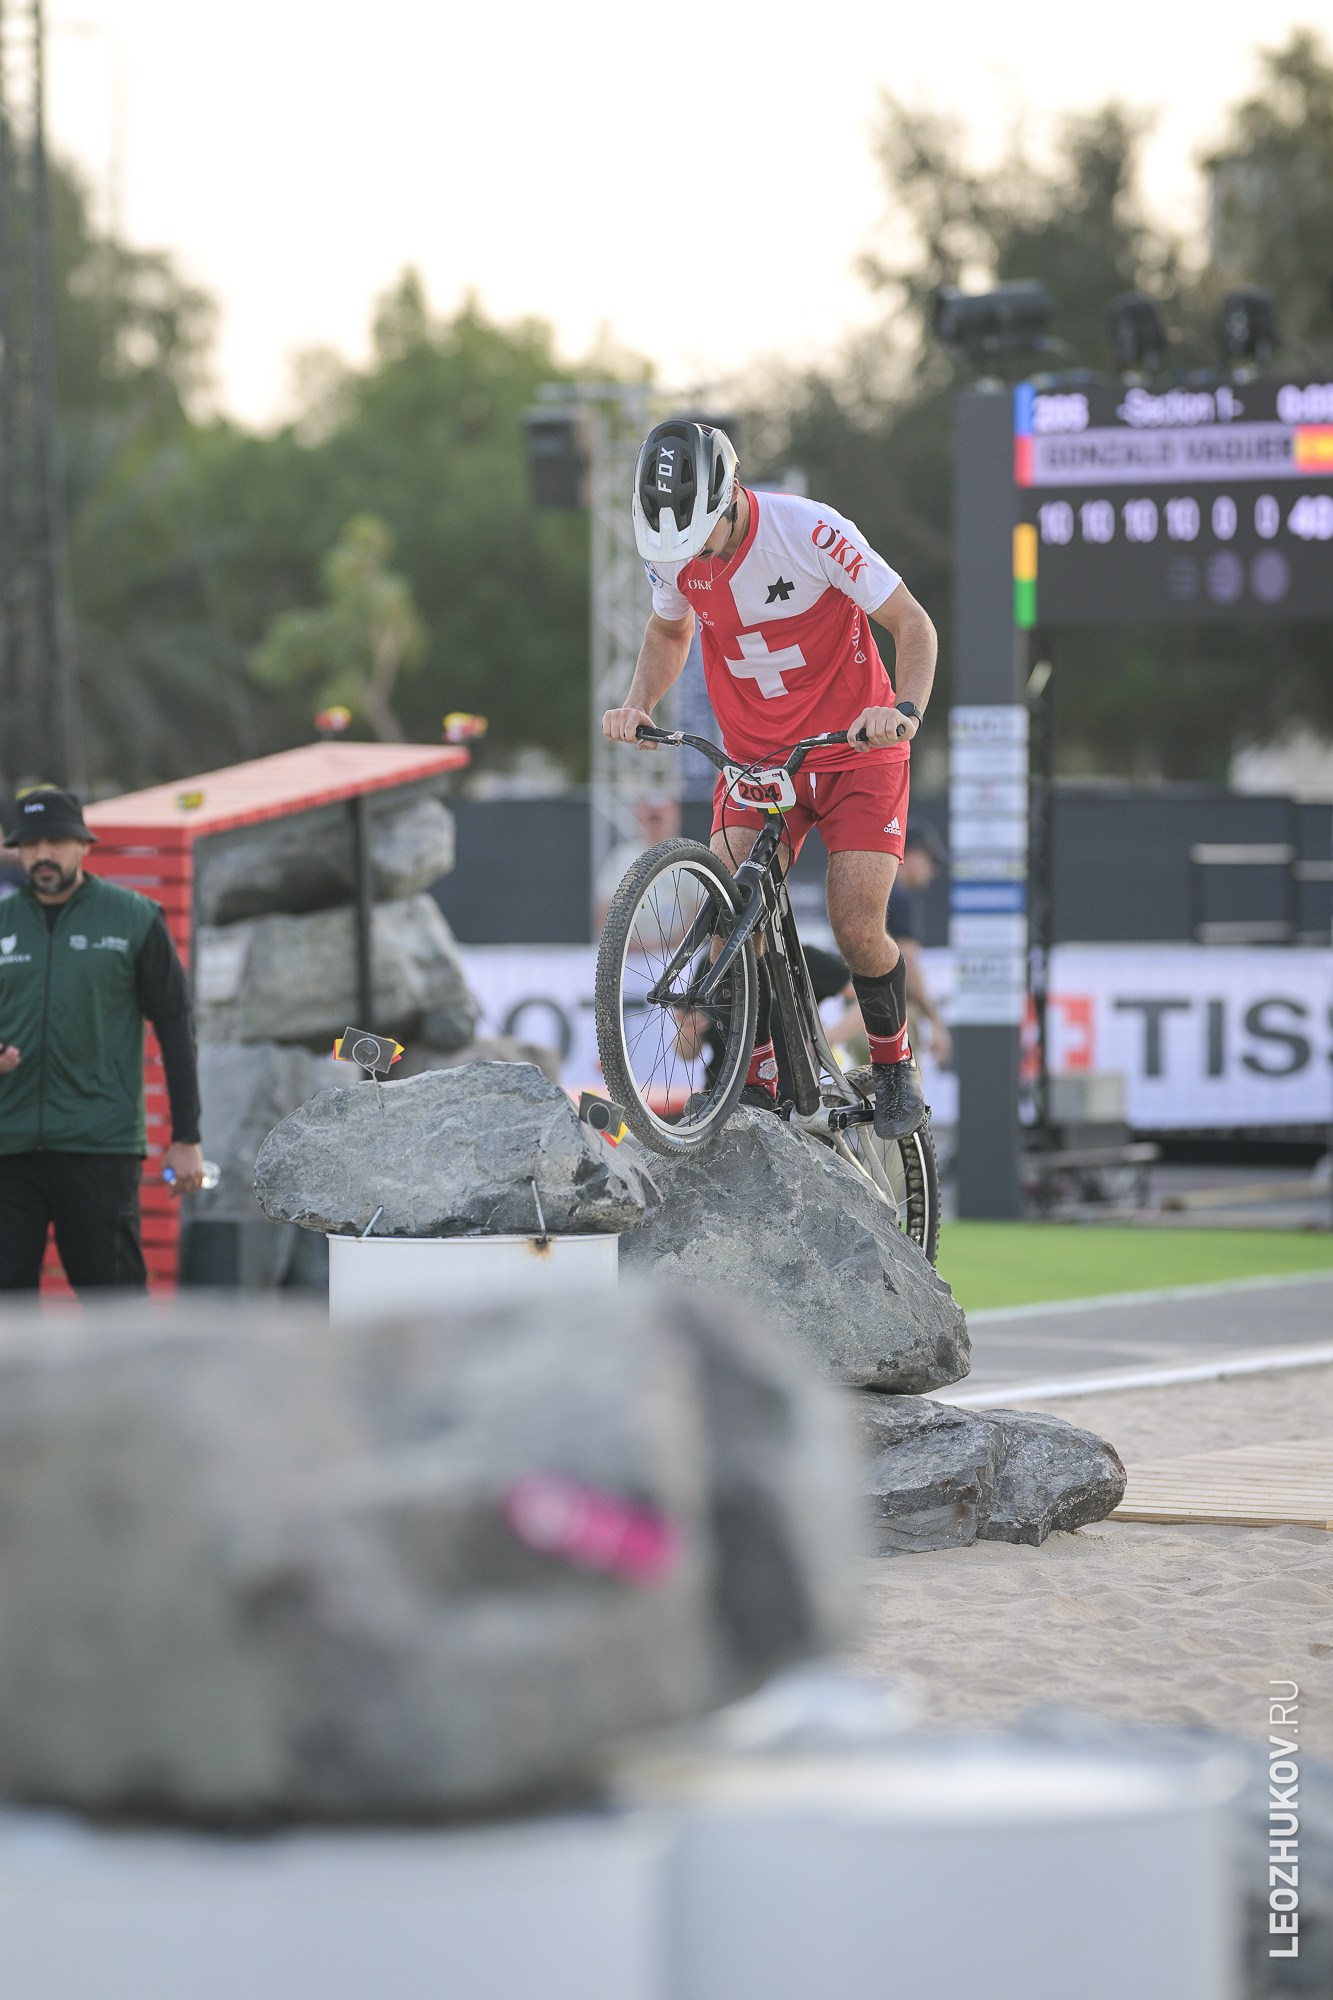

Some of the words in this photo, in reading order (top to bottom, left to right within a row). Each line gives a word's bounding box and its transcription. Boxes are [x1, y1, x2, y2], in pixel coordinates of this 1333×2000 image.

[658, 447, 675, 494] FOX
[1044, 440, 1175, 470] GONZALO
[1037, 499, 1075, 545] 10
[1079, 498, 1116, 544] 10
[1121, 497, 1159, 543] 10
[1164, 496, 1201, 542] 10
[1211, 494, 1238, 541] 0
[1253, 493, 1280, 540] 0
[812, 520, 868, 583] ÖKK
[740, 783, 779, 802] 204
[1112, 999, 1333, 1078] TIS
